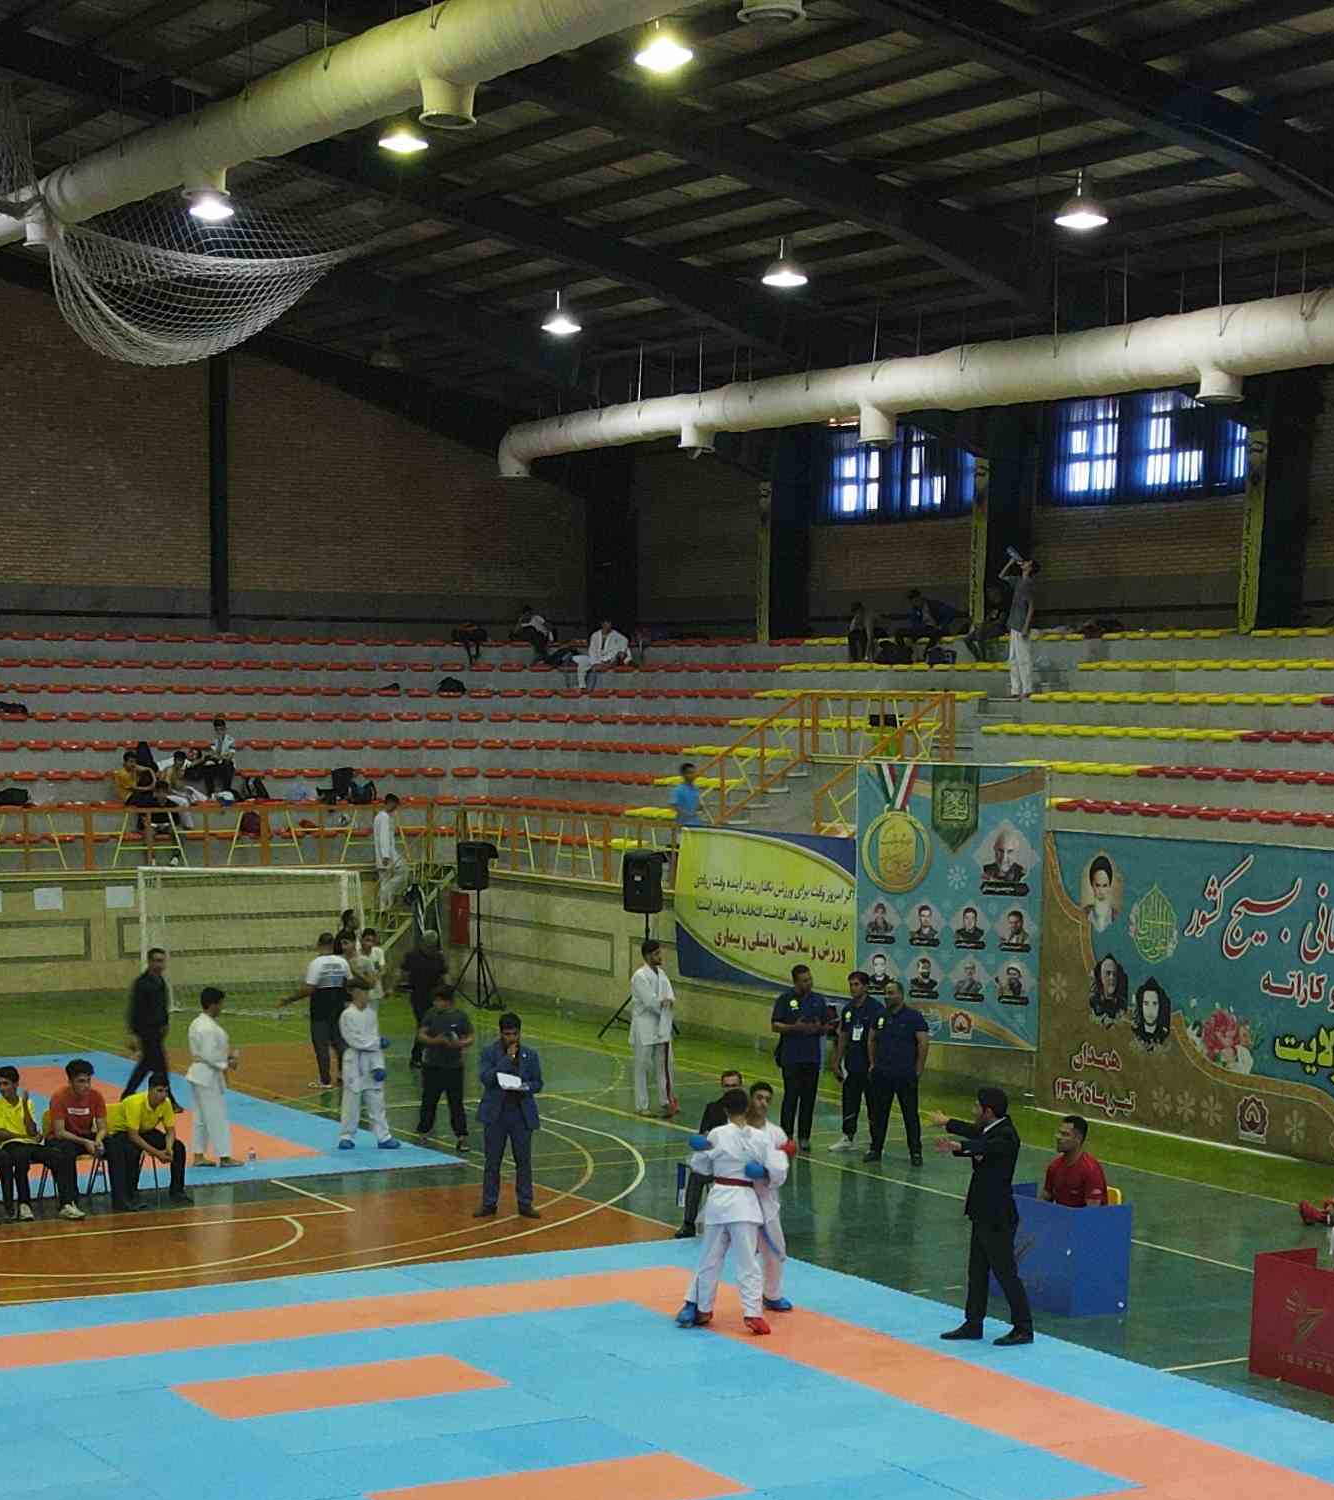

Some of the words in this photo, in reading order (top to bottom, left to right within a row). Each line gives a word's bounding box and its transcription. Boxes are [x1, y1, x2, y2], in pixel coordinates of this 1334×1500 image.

[1184, 854, 1254, 938] کشور
[1222, 877, 1303, 960] بسیج
[1261, 970, 1327, 1008] کاراته
[1071, 1042, 1123, 1072] همدان
